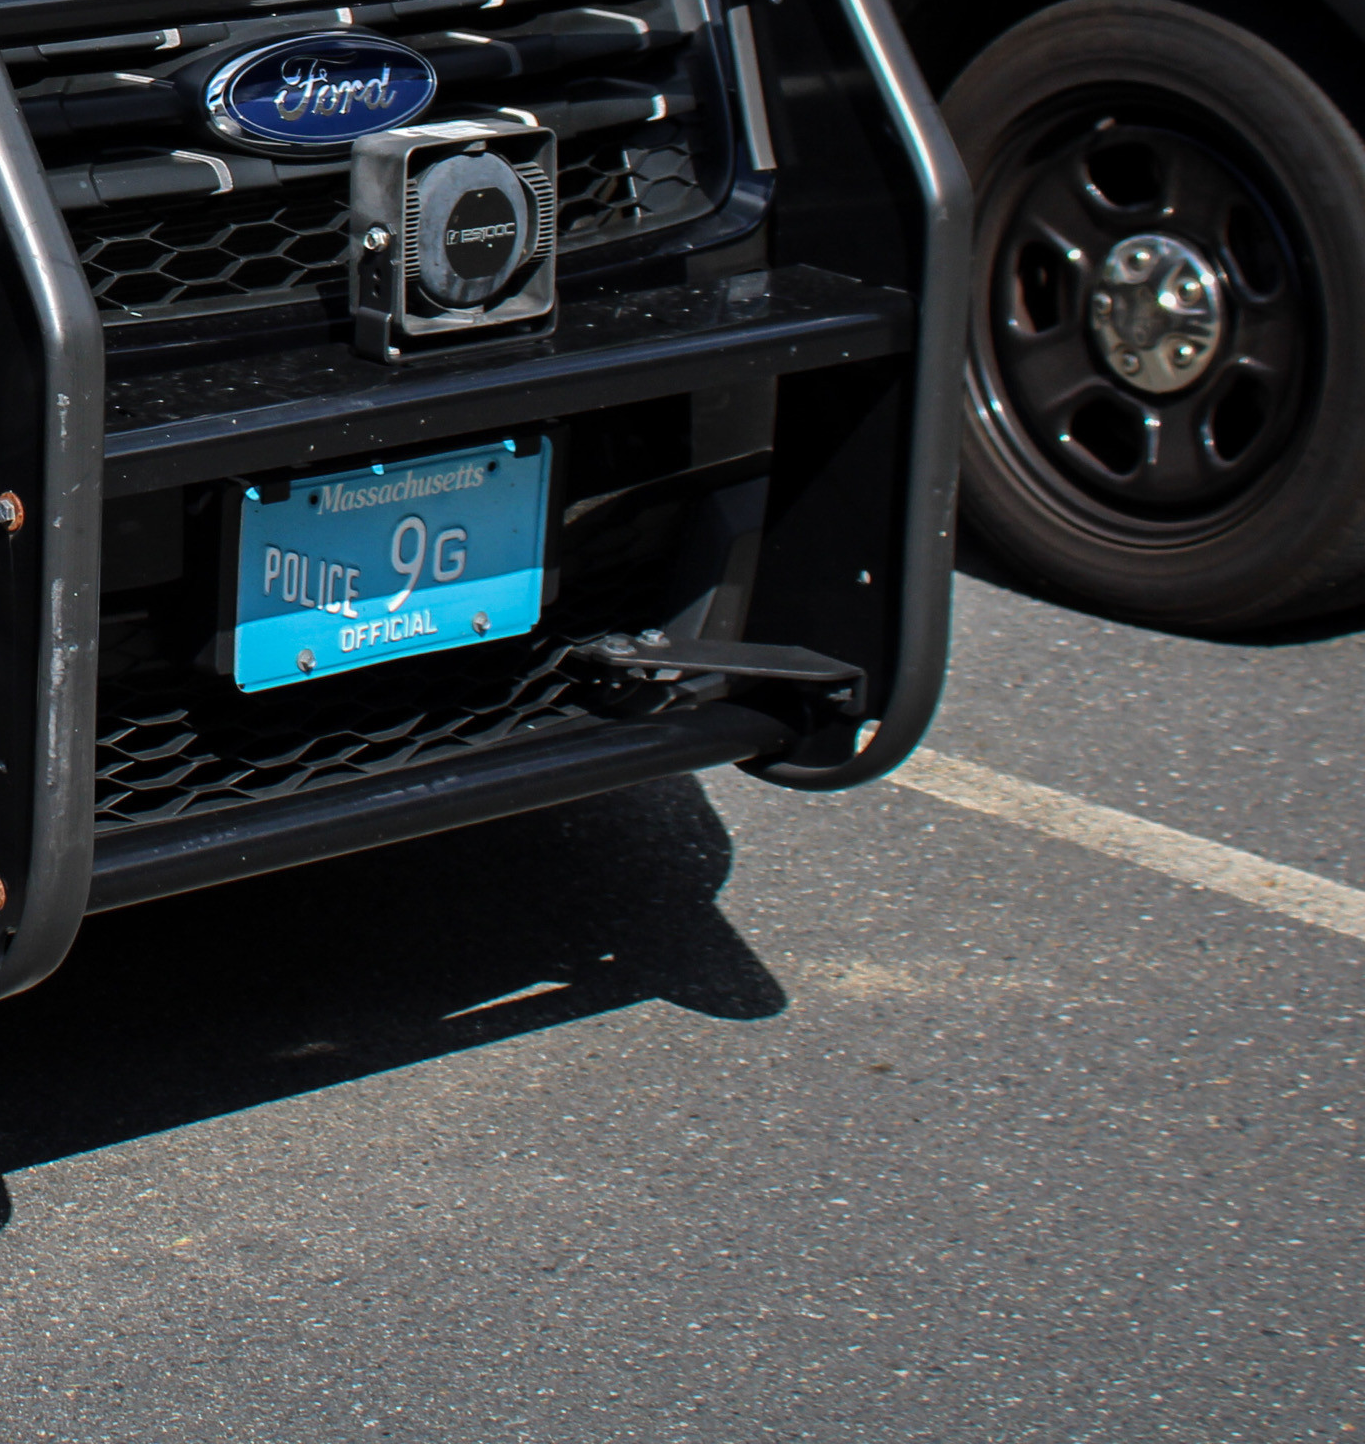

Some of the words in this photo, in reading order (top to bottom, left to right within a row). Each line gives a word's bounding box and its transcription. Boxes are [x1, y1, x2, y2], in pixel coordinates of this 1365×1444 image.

[275, 52, 398, 122] Ford
[317, 463, 485, 515] Massachusetts
[264, 545, 361, 619] POLICE
[339, 609, 438, 653] OFFICIAL
